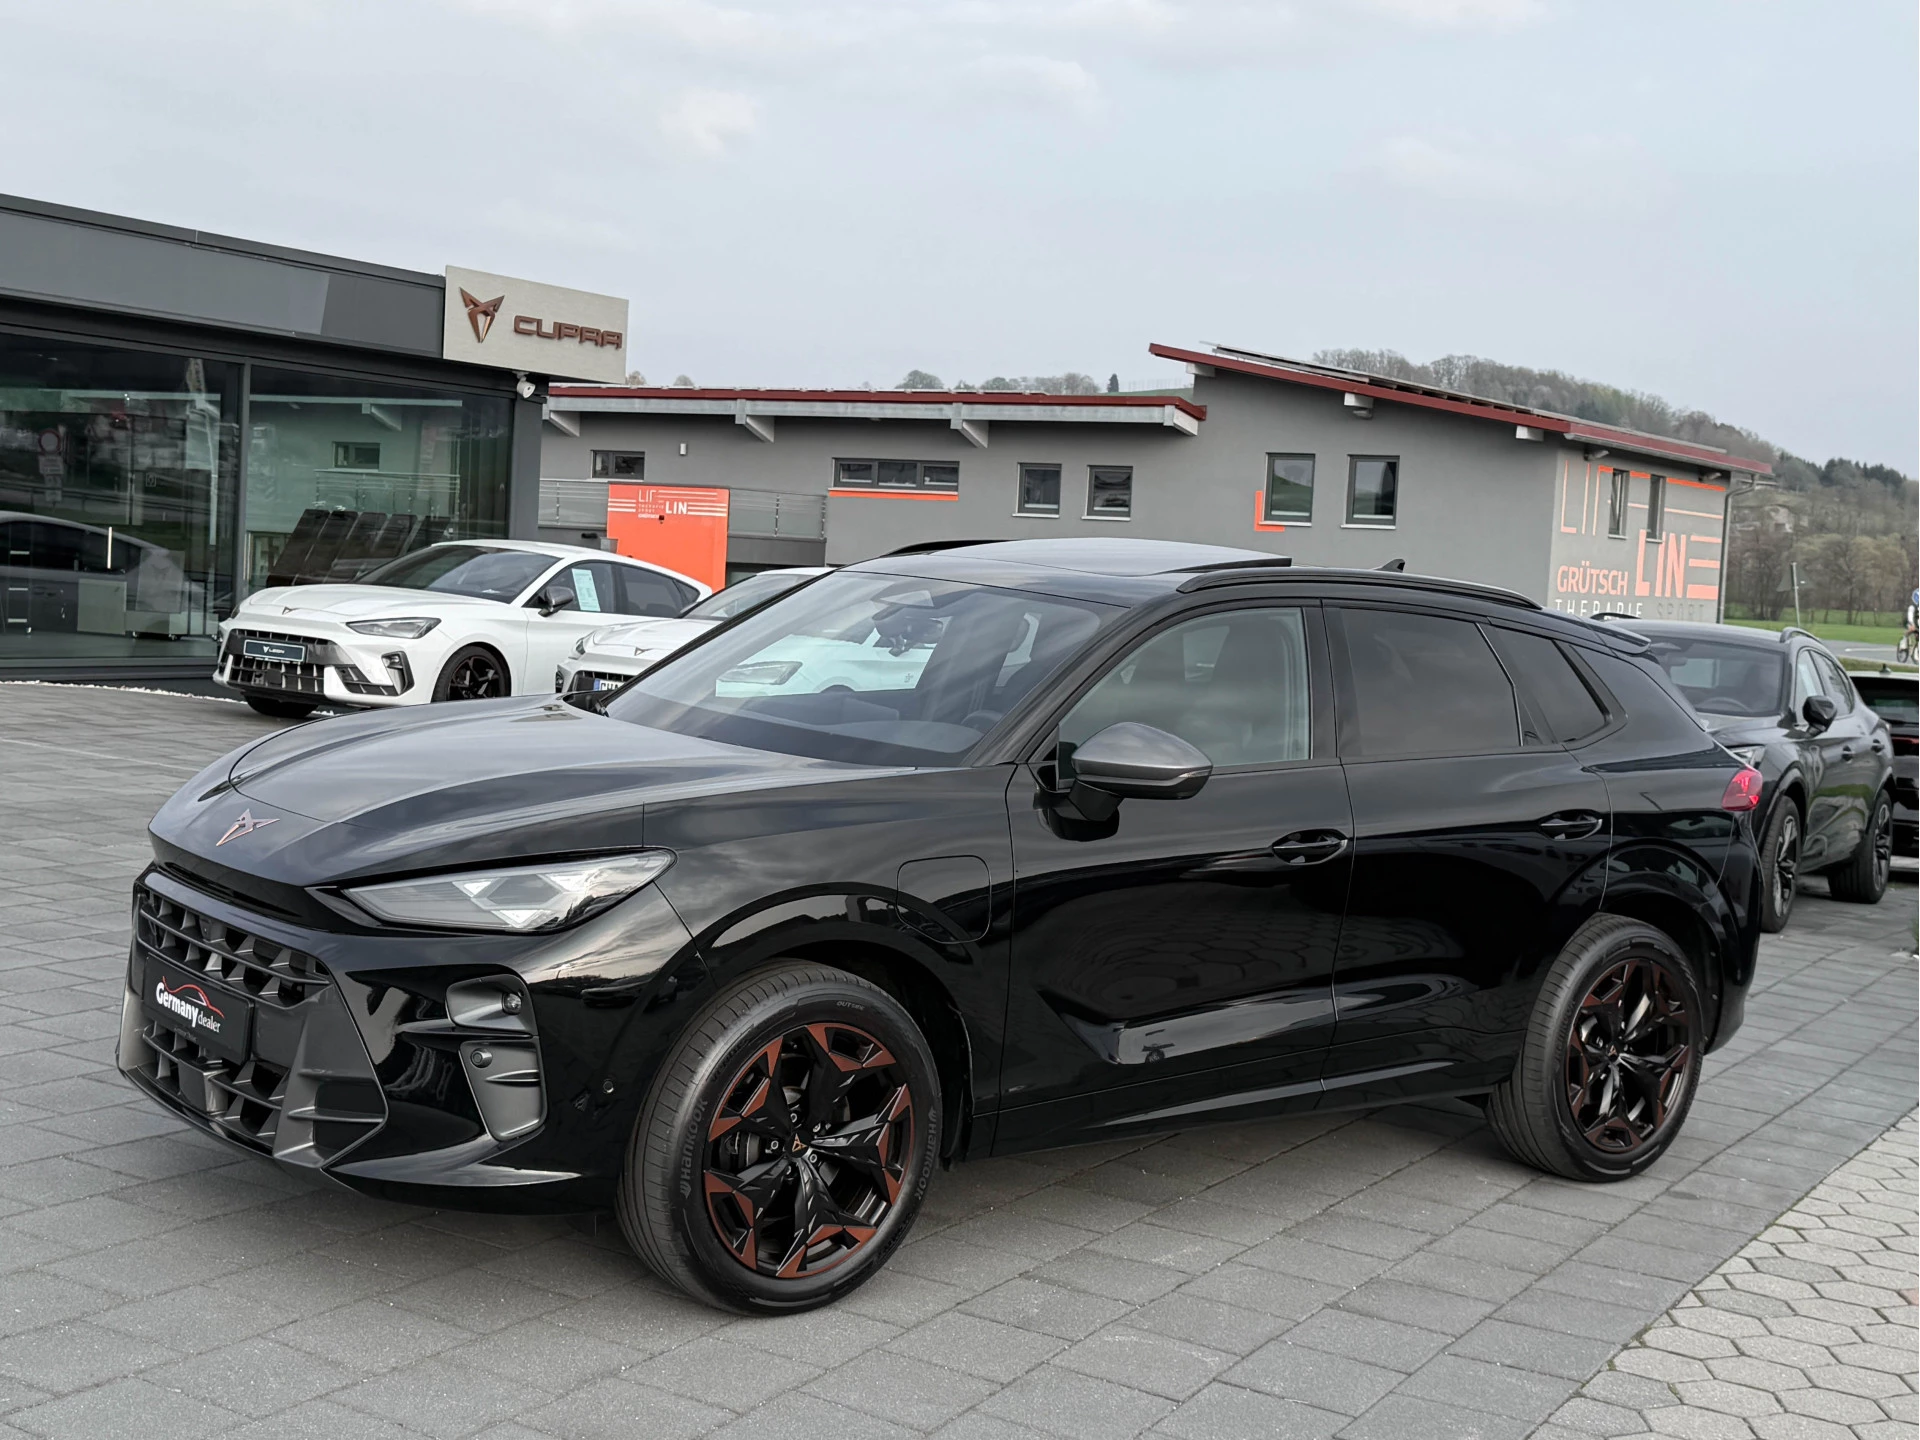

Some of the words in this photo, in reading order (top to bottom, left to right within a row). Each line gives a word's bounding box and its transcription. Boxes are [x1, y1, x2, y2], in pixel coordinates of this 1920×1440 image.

[513, 315, 623, 350] CUPRA
[1557, 560, 1629, 596] GRÜTSCH
[156, 981, 199, 1028] Germany
[197, 1010, 221, 1033] dealer
